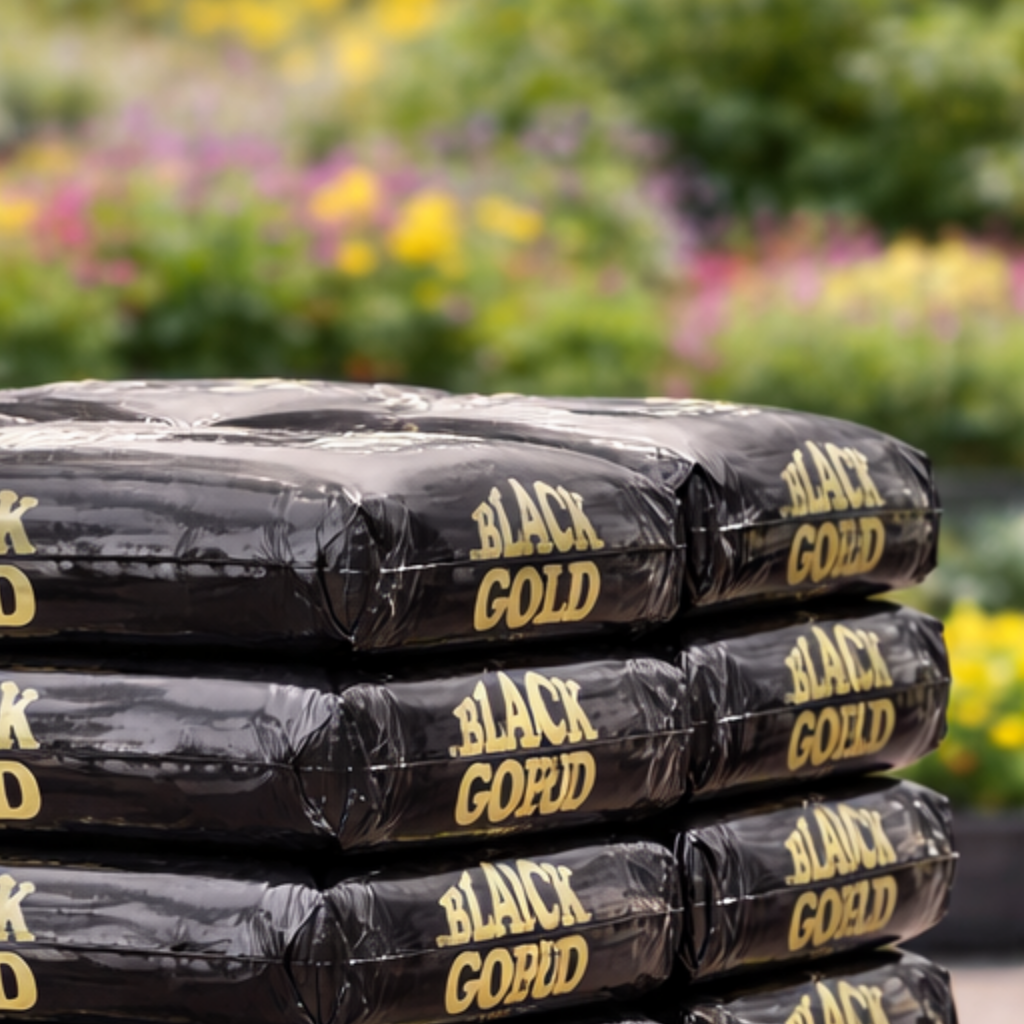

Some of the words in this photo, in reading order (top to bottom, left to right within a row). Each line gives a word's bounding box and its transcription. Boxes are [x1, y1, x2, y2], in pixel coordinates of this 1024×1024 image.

[469, 477, 605, 561] BLACK
[473, 560, 601, 631] GOLD
[449, 672, 599, 757] BLACK
